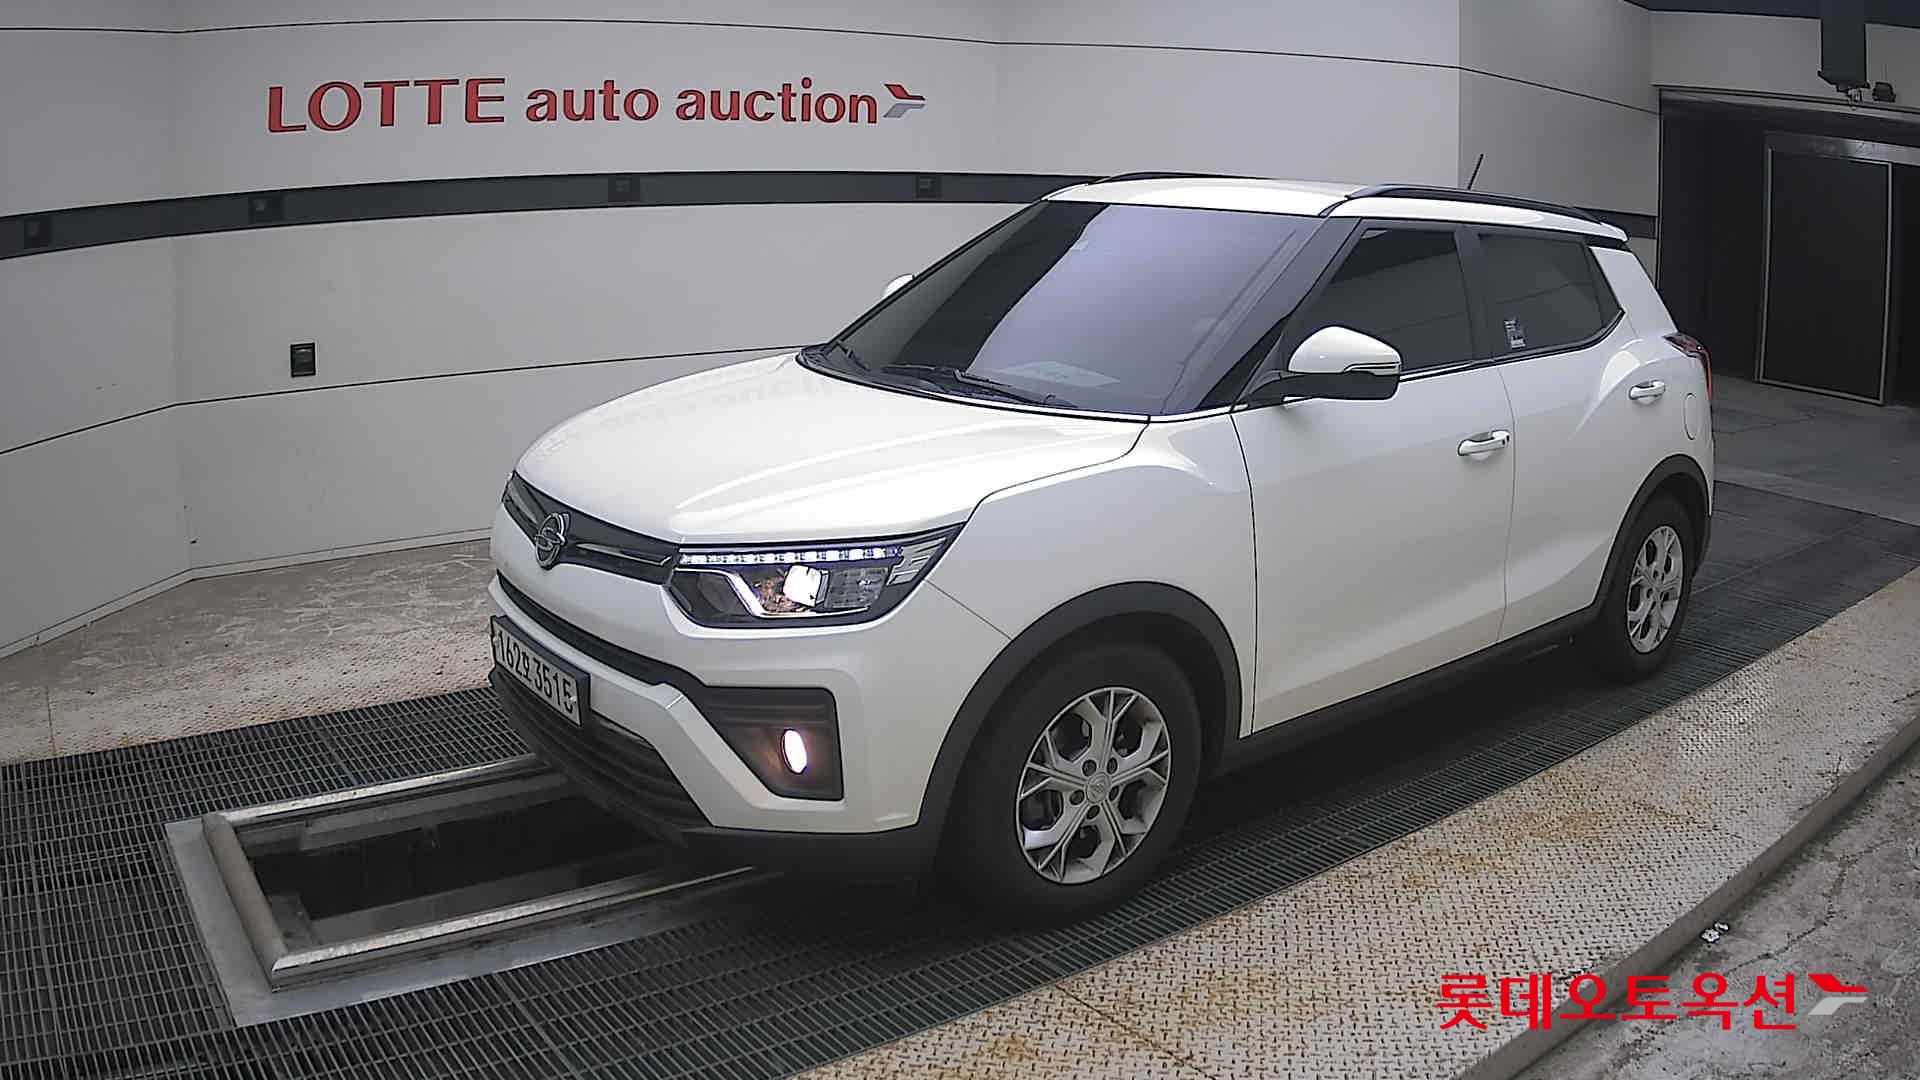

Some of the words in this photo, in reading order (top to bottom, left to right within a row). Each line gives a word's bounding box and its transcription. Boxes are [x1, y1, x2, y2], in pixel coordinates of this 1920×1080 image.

[267, 78, 505, 133] LOTTE
[525, 79, 659, 122] auto
[675, 76, 878, 124] auction
[532, 656, 577, 714] 3515
